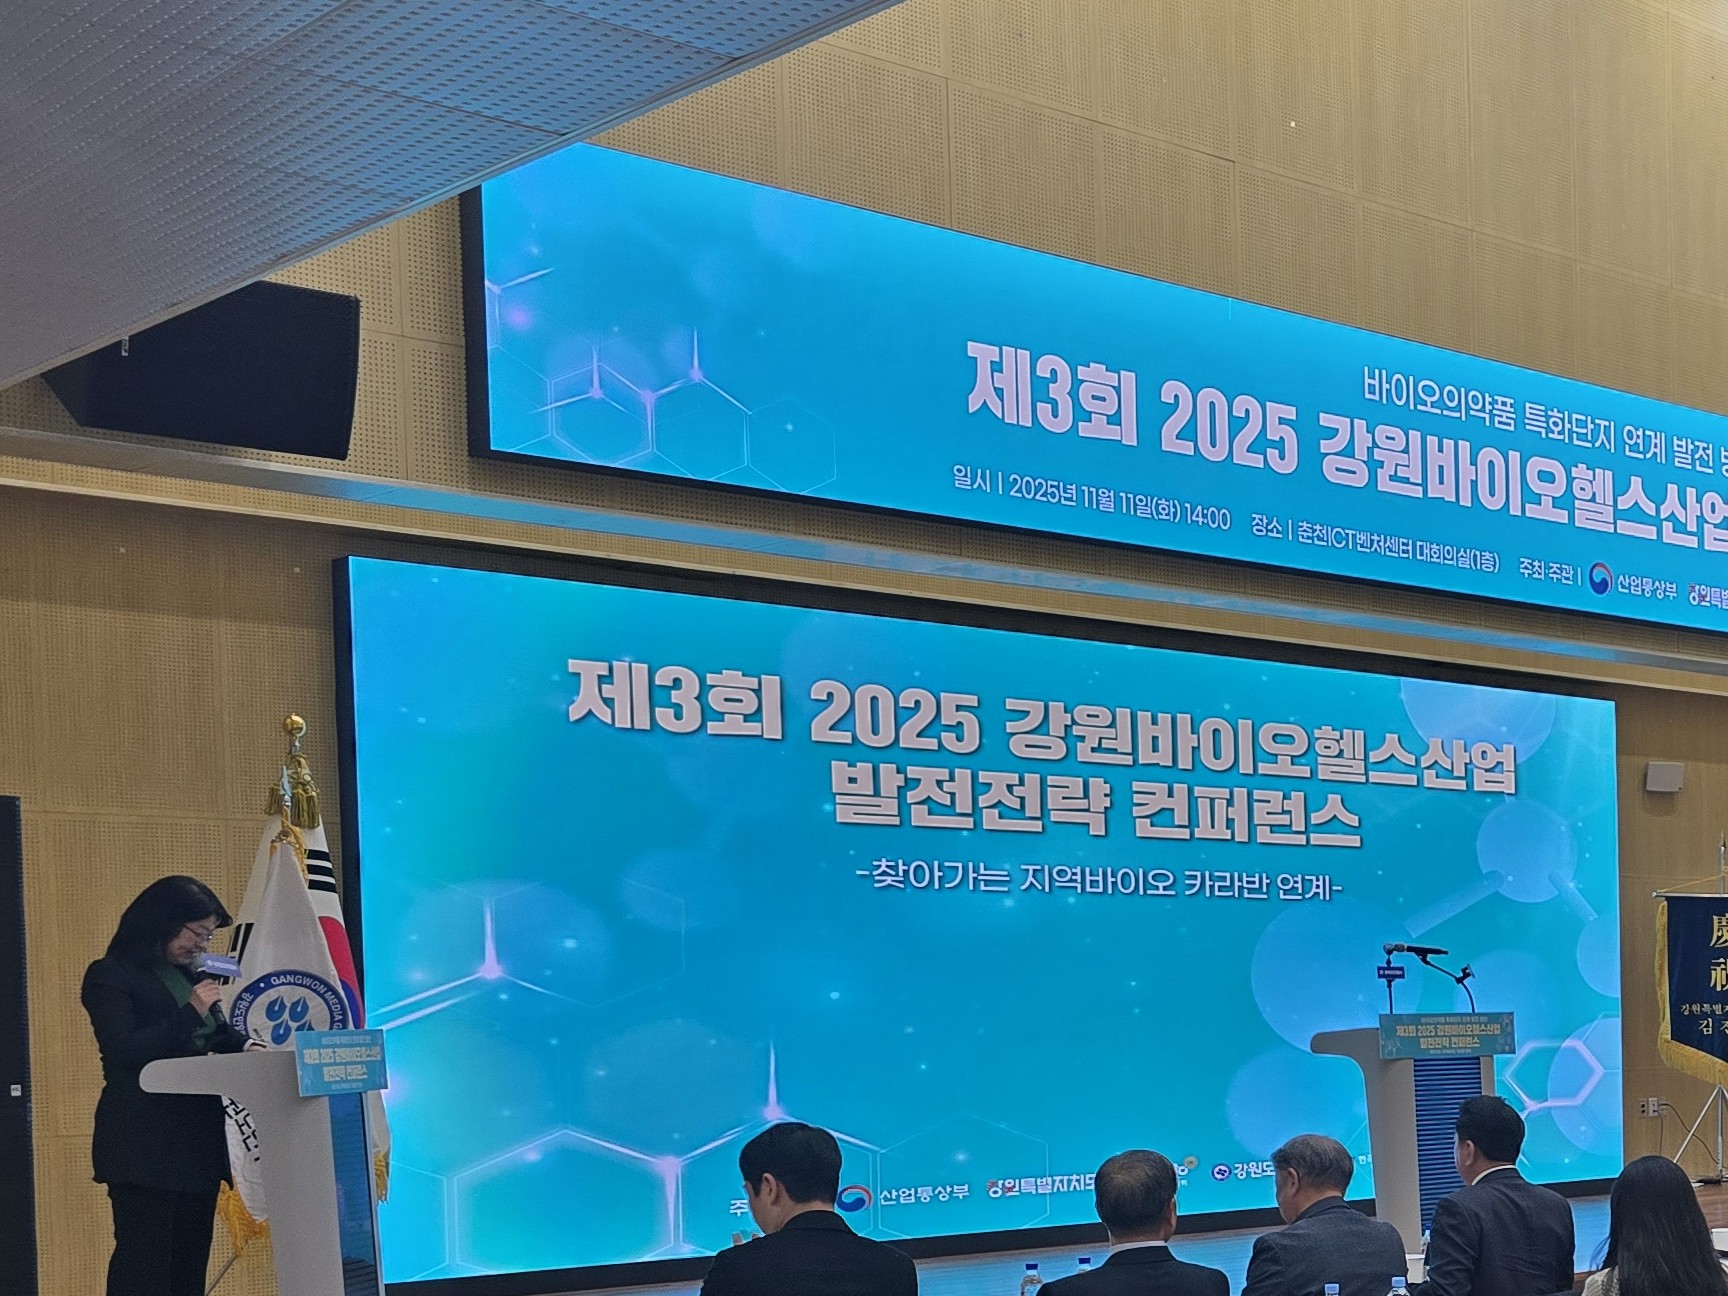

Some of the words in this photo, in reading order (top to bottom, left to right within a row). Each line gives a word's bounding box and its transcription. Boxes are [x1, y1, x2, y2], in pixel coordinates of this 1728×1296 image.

[966, 340, 1139, 448] 제3회
[1160, 379, 1299, 475] 2025
[1363, 365, 1516, 432] 바이오의약품
[1524, 402, 1616, 454] 특화단지
[1623, 424, 1666, 464] 연계
[1673, 435, 1714, 475] 발전
[953, 464, 991, 493] 일시
[1009, 473, 1077, 507] 2025년
[1082, 485, 1115, 513] 11월
[1119, 491, 1181, 524] 11일(화)
[1184, 502, 1231, 531] 14:00
[1251, 513, 1283, 540] 장소
[1297, 519, 1413, 560] 춘천ICT벤처센터
[1416, 540, 1500, 574] 대회의실(1층)
[1617, 573, 1678, 601] 산업통상부
[566, 656, 783, 741] 제3회
[808, 678, 983, 755] 2025
[1004, 696, 1518, 796] 강원바이오헬스산업
[830, 758, 1112, 837] 발전전략
[1130, 779, 1364, 849] 컨퍼런스
[1019, 863, 1177, 897] 지역바이오
[1183, 869, 1271, 900] 카라반
[270, 974, 327, 995] GANGWON
[323, 991, 344, 1023] MEDIA
[878, 1183, 970, 1206] 산업통상부
[1234, 1160, 1275, 1178] 강원도
